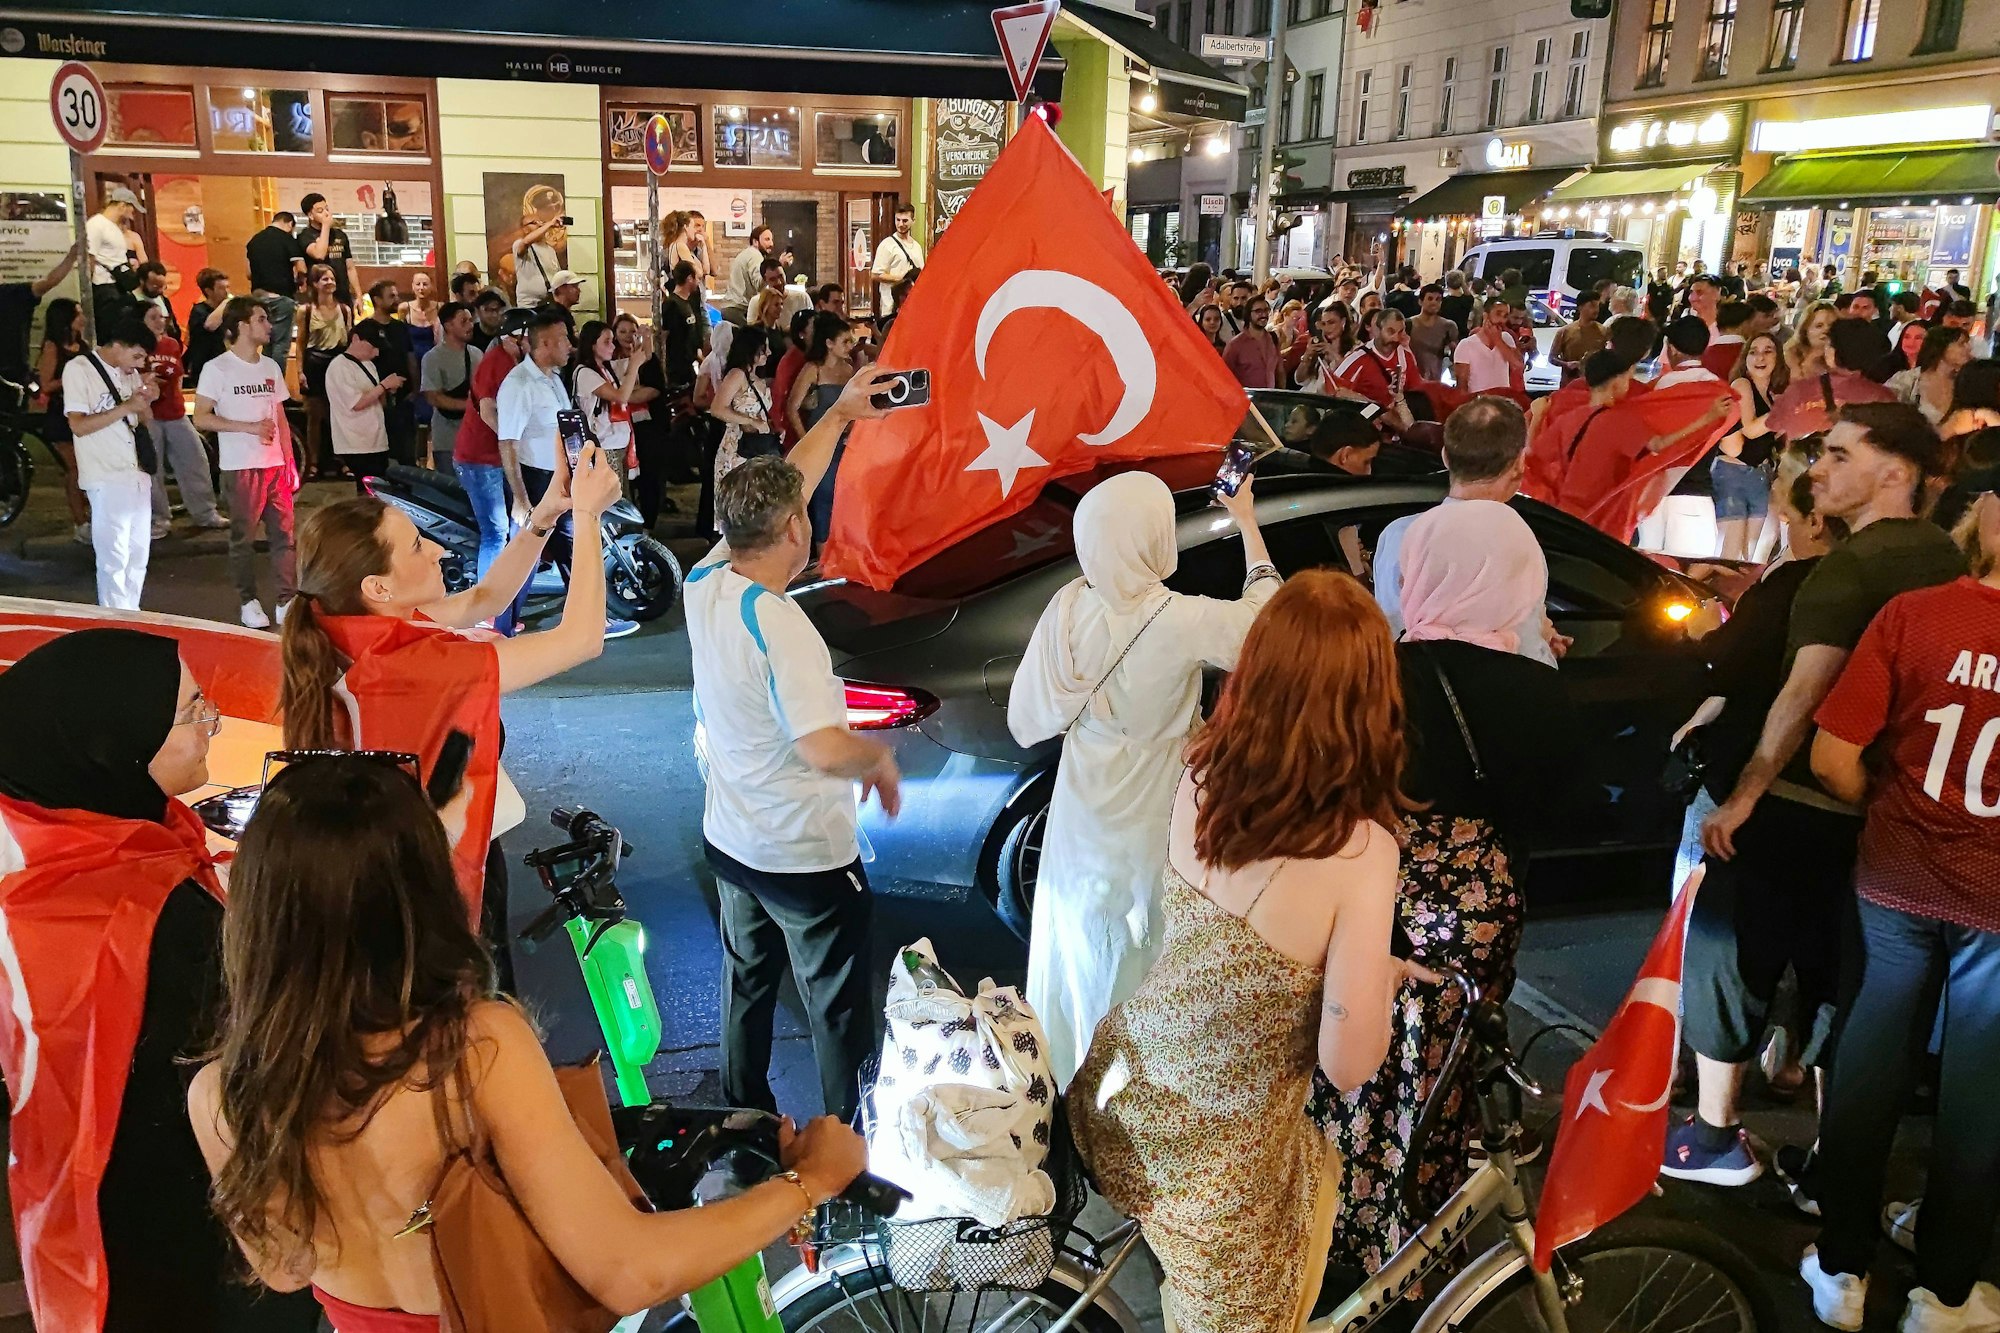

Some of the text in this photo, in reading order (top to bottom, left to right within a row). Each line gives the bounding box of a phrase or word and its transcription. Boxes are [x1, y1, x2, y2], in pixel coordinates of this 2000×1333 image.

[38, 32, 106, 55] Warsteiner
[1211, 40, 1261, 55] Adalbertstraße
[505, 62, 621, 75] HASIR HB BURGER
[64, 87, 96, 129] 30
[949, 98, 997, 123] BURGER
[945, 150, 990, 161] VERSCHIEDENE
[951, 163, 985, 176] SORTEN
[0, 225, 30, 235] rvice
[1924, 702, 2000, 818] 10
